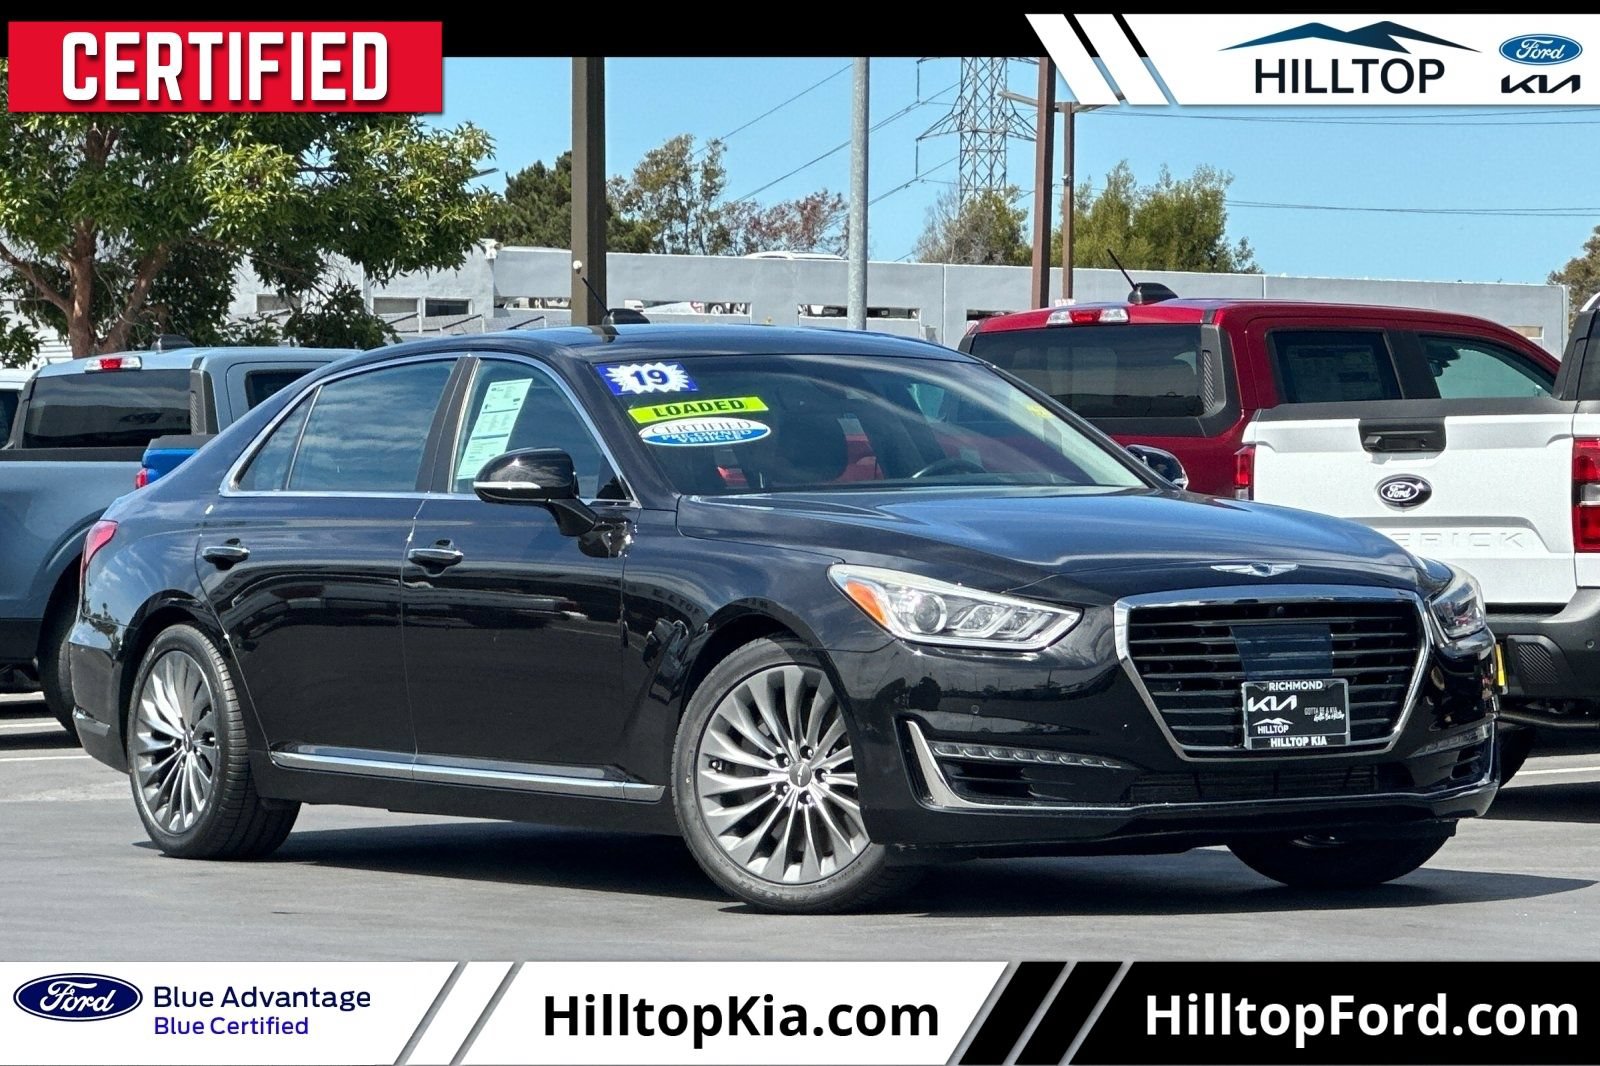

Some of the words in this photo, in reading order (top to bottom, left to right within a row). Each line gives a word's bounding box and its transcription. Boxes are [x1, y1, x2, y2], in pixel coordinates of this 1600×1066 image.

[630, 369, 669, 387] 19
[652, 400, 745, 417] LOADED
[652, 420, 752, 435] CERTIFIED
[1387, 484, 1411, 499] Ford
[1269, 681, 1323, 691] RICHMOND
[1248, 695, 1297, 712] KIA
[1257, 724, 1289, 735] HILLTOP
[1270, 736, 1309, 748] HILLTOP
[1311, 735, 1327, 746] KIA
